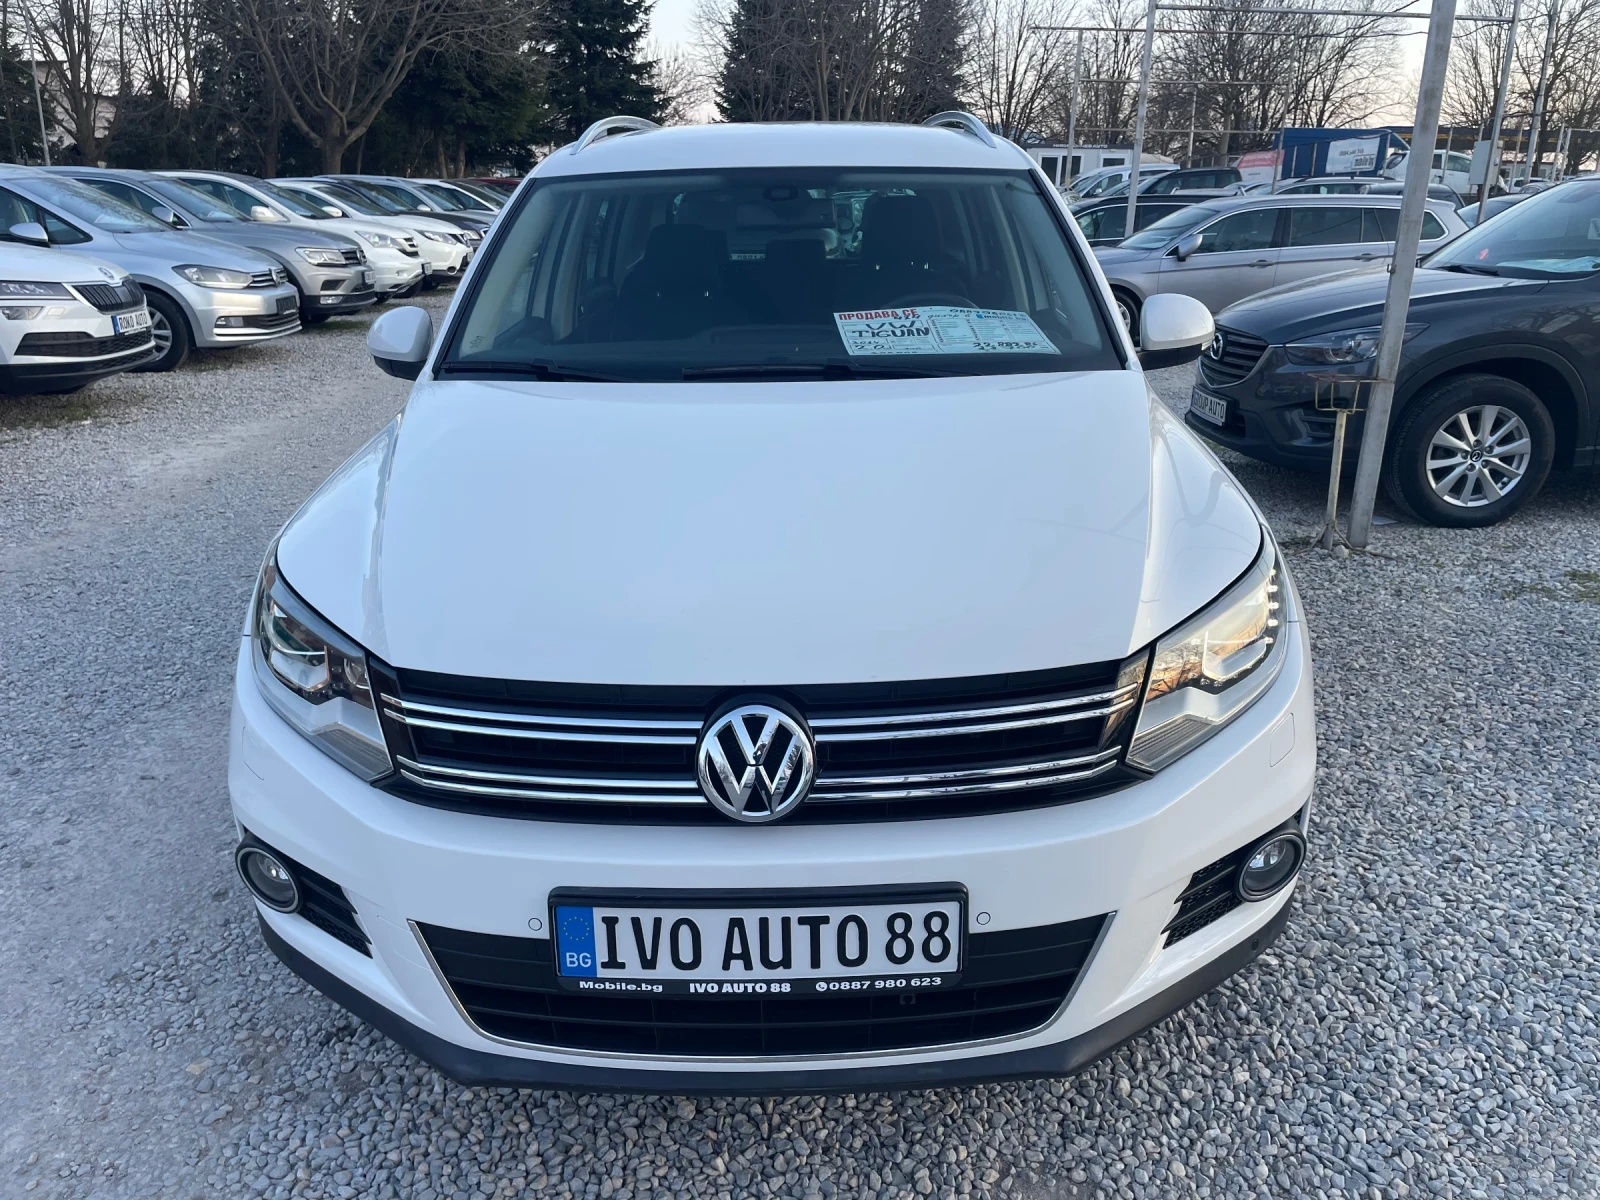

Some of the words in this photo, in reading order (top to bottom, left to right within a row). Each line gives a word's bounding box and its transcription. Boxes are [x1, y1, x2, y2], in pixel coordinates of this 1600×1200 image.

[838, 310, 899, 321] ПРОДАВА
[902, 308, 918, 318] СЕ
[851, 327, 930, 338] TIGUAN
[865, 320, 917, 331] VW
[1208, 399, 1225, 419] AUTO
[600, 916, 702, 971] IVO
[721, 914, 868, 971] AUTO
[885, 911, 952, 965] 88
[565, 952, 592, 968] BG
[579, 980, 663, 993] Mobile.bg
[689, 982, 719, 993] IVO
[721, 982, 767, 993] AUTO
[770, 982, 791, 993] 88
[829, 980, 871, 991] 0887
[874, 978, 906, 989] 980
[911, 977, 942, 987] 623
